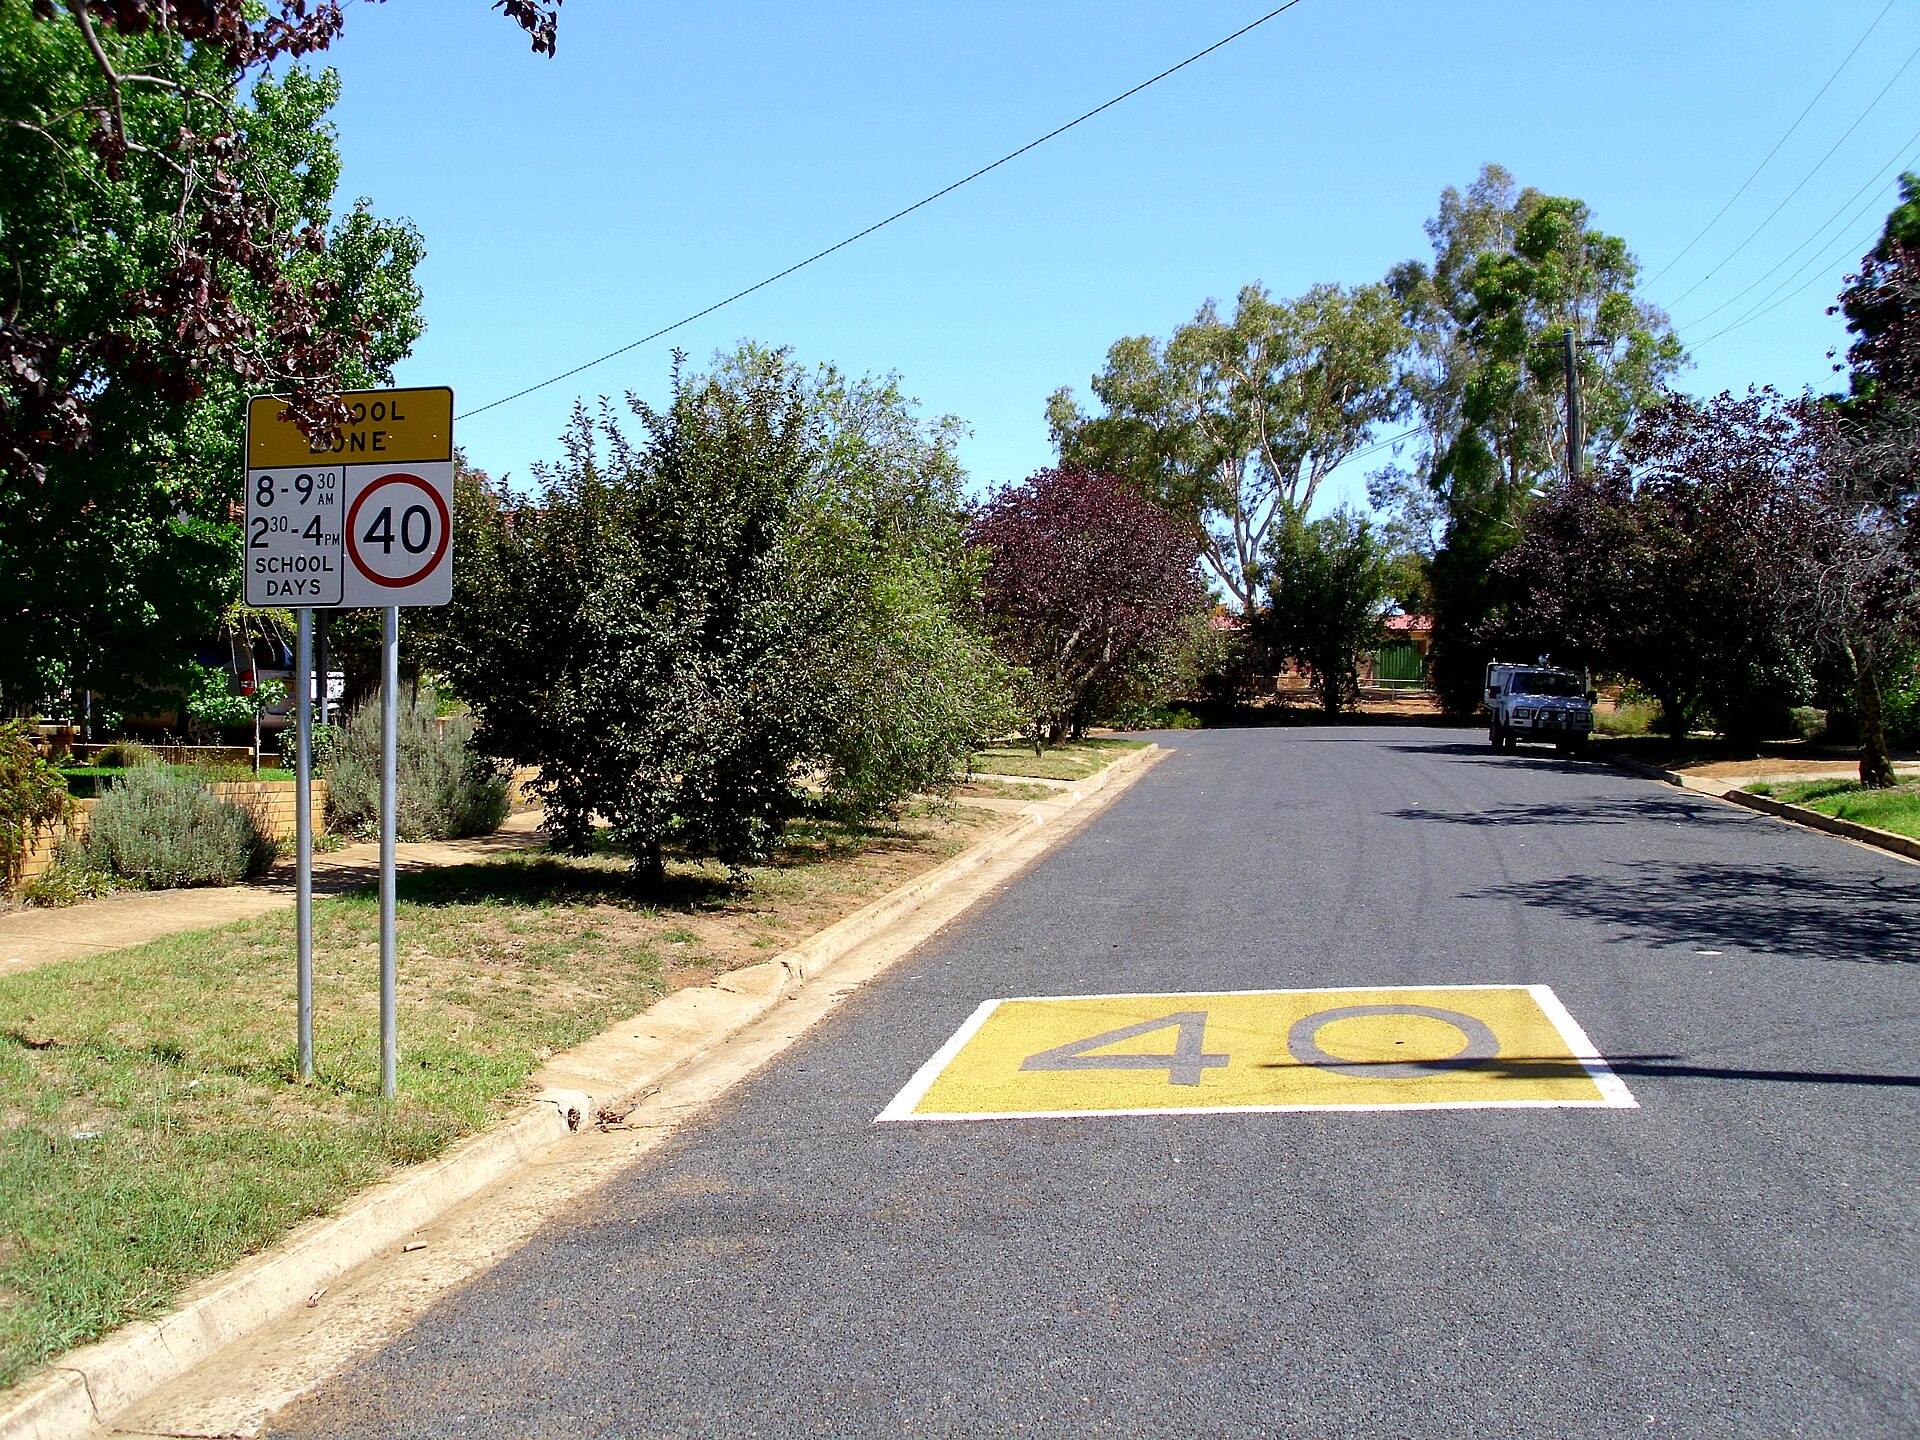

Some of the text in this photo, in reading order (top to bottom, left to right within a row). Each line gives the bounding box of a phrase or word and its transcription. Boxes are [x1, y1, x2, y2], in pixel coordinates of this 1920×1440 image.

[317, 493, 334, 506] AM
[363, 504, 432, 555] 40
[254, 556, 334, 574] SCHOOL
[266, 579, 321, 597] DAYS
[1017, 1003, 1501, 1086] 40
